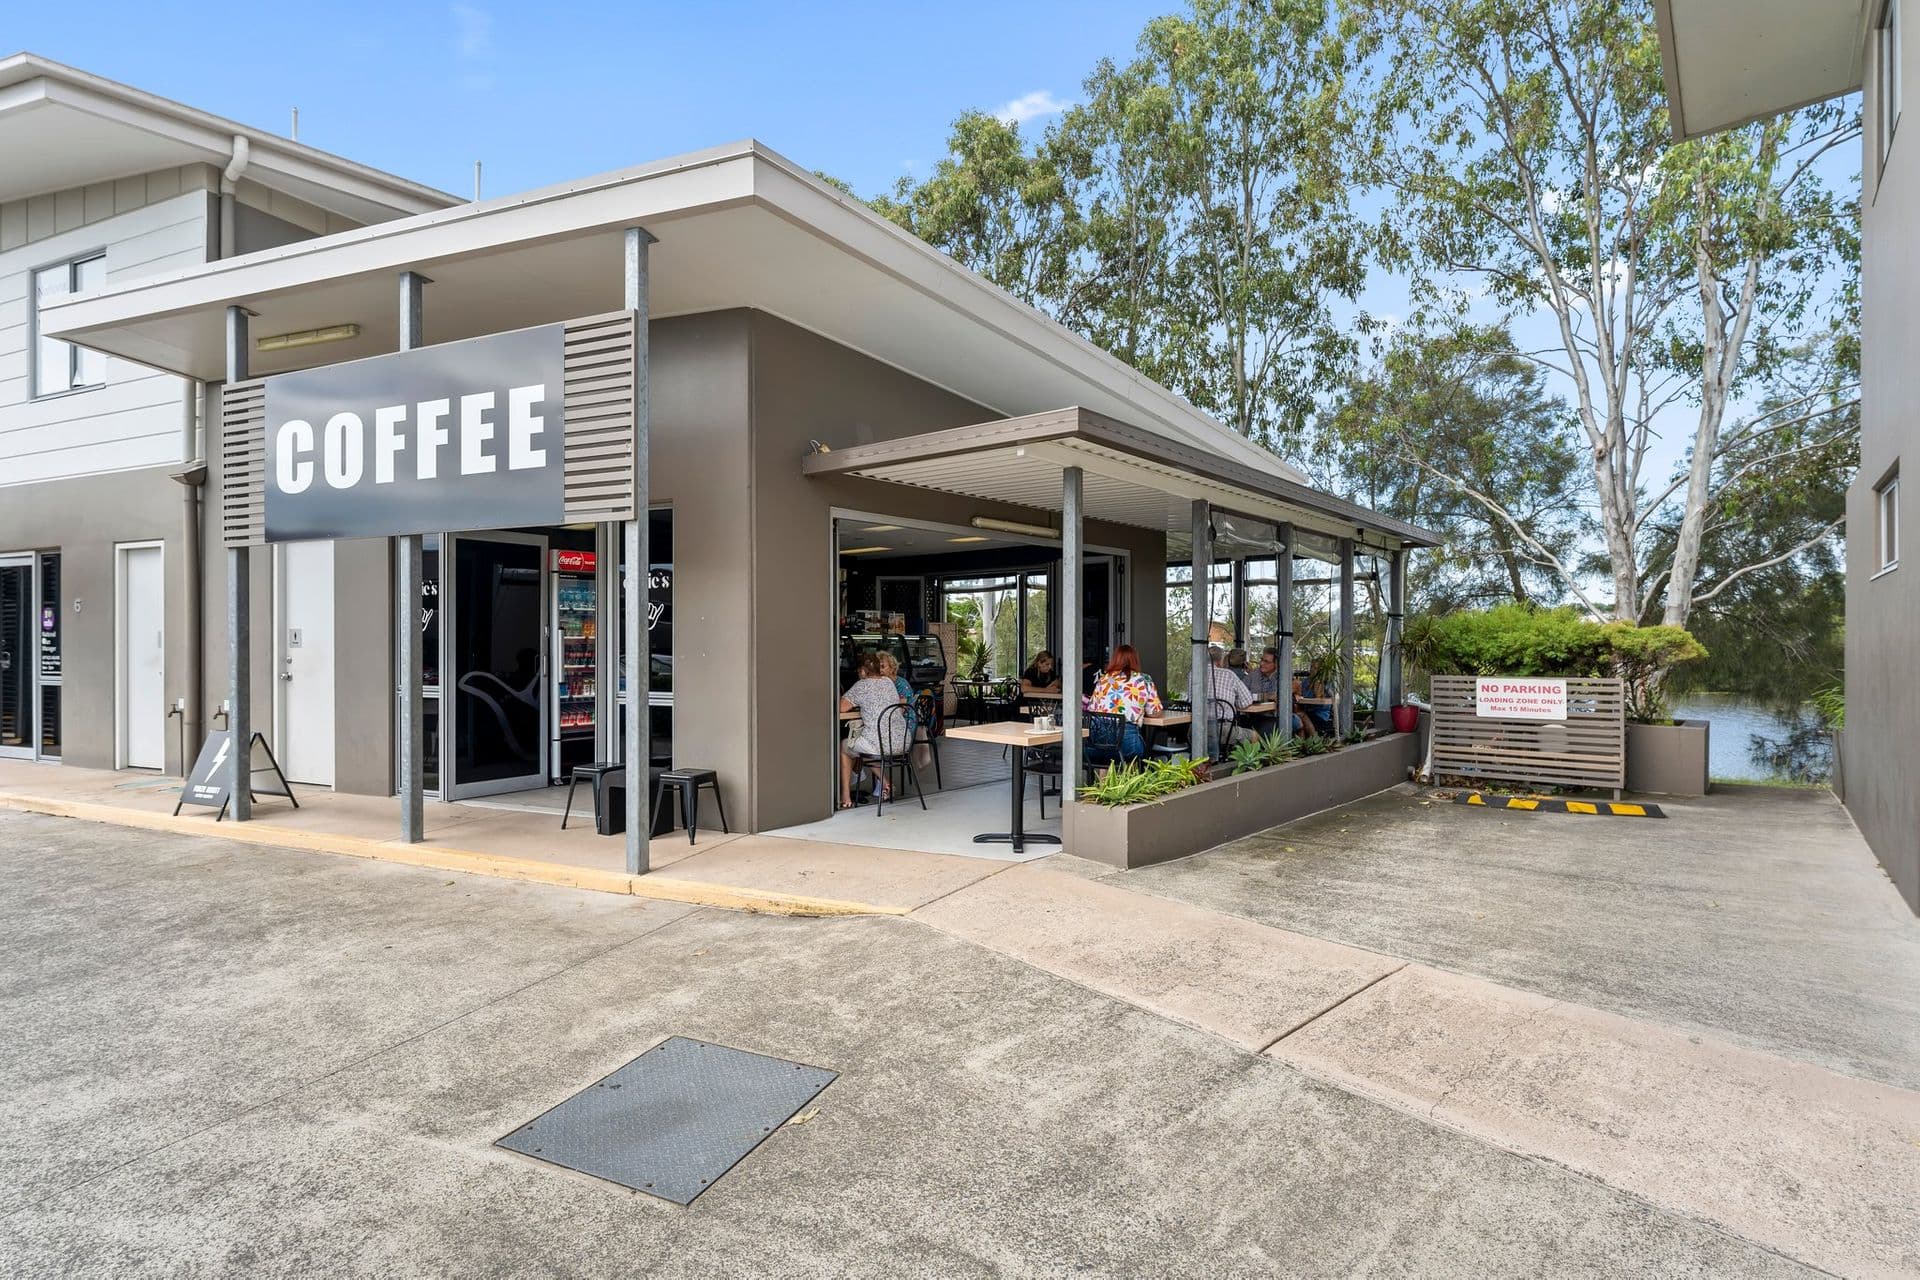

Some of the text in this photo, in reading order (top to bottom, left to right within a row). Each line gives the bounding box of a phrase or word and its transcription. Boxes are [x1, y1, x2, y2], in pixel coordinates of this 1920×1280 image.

[276, 383, 547, 494] COFFEE
[1481, 684, 1562, 694] NO PARKING
